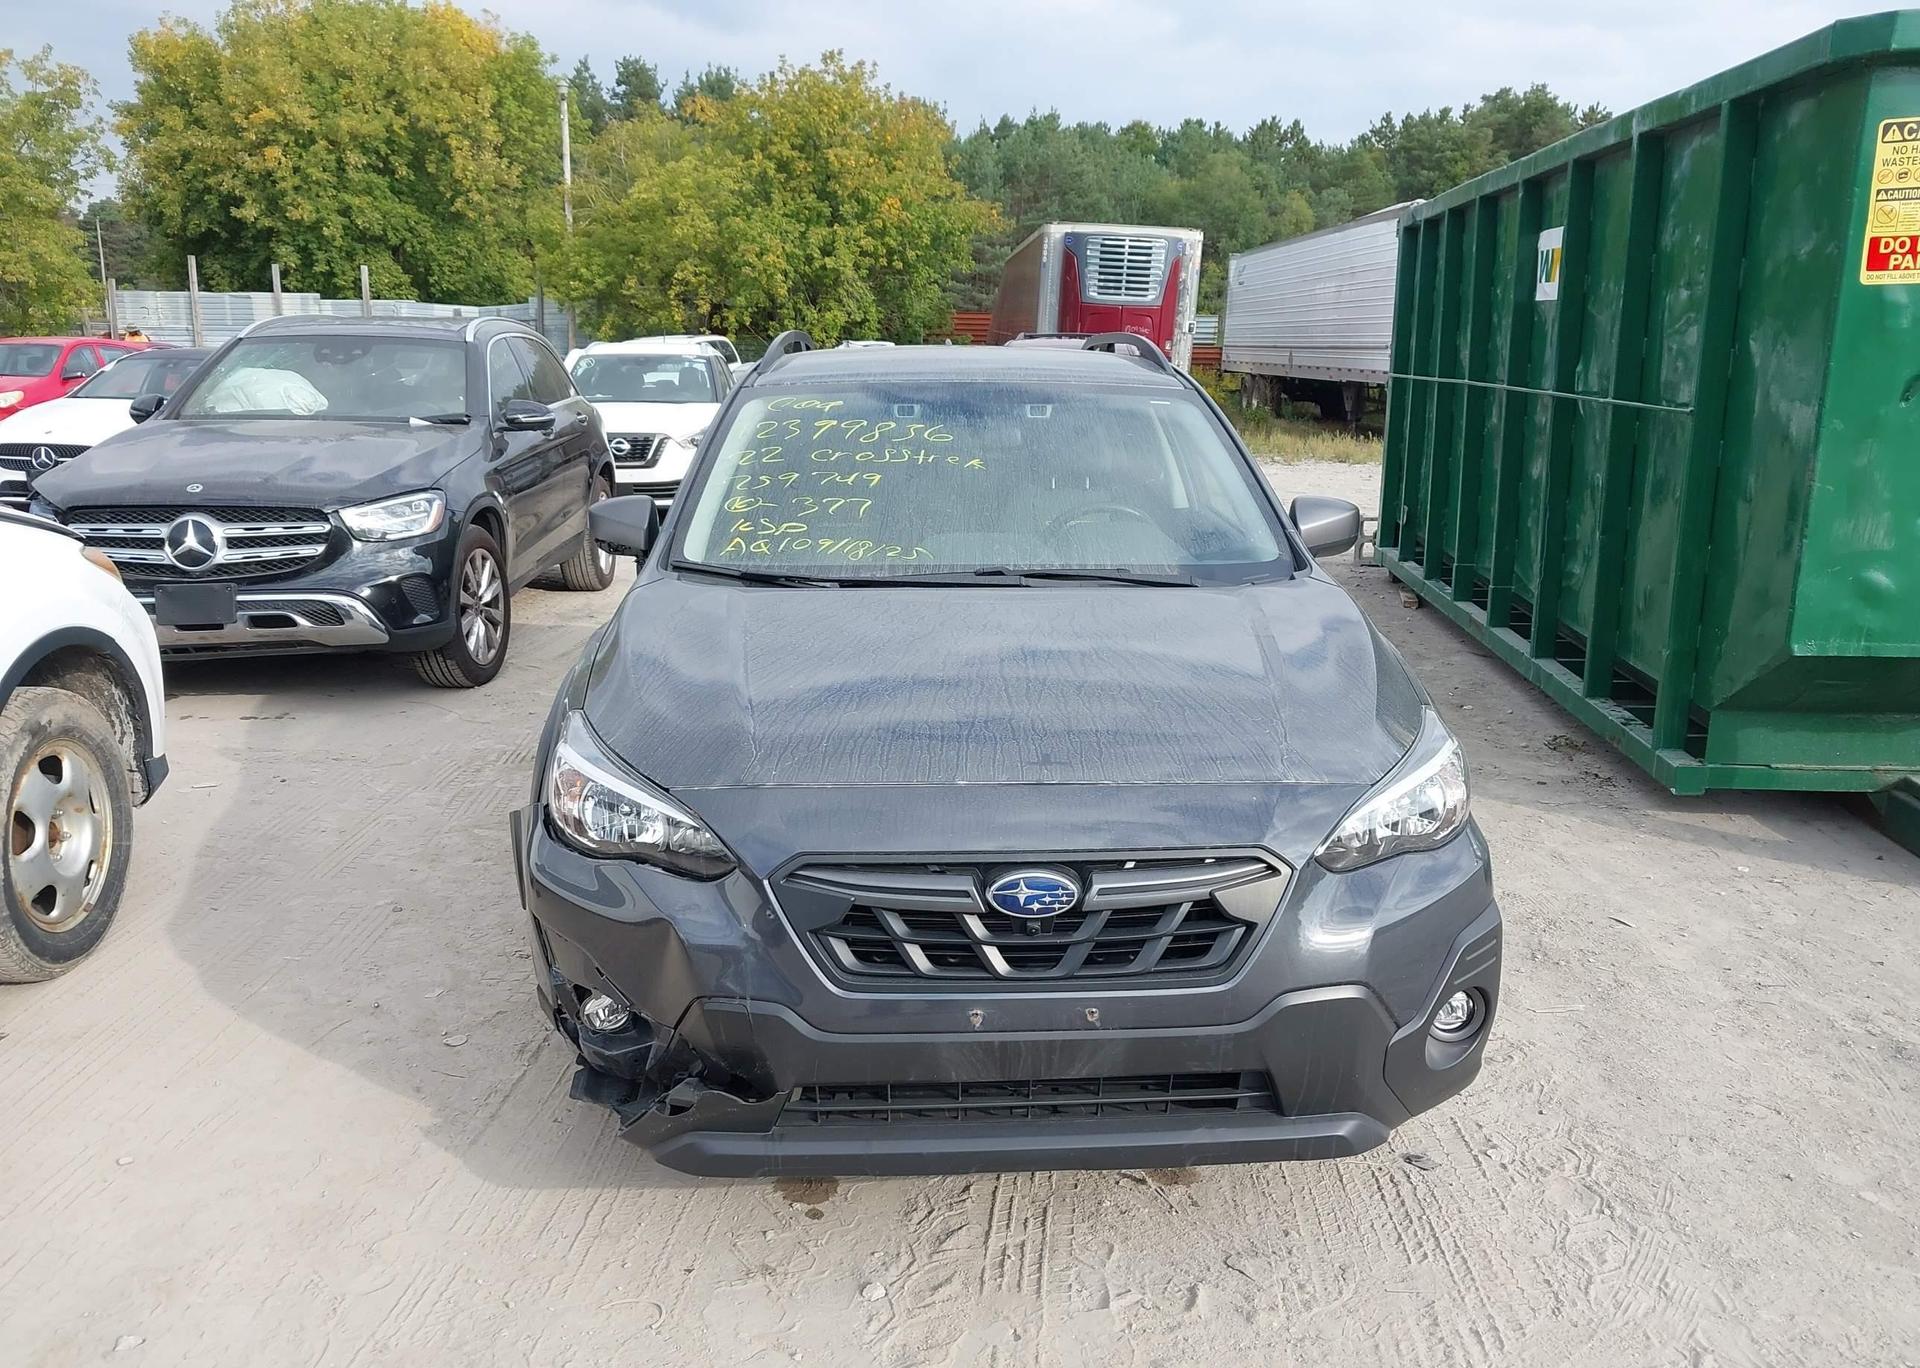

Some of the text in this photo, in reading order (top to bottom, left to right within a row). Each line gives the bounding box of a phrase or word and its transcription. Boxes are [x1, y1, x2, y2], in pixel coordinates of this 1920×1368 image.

[1892, 145, 1909, 155] NO
[1881, 155, 1920, 167] WASTE
[1879, 236, 1911, 254] DO
[1866, 273, 1874, 281] DO
[737, 446, 785, 466] 22
[791, 496, 873, 519] 377
